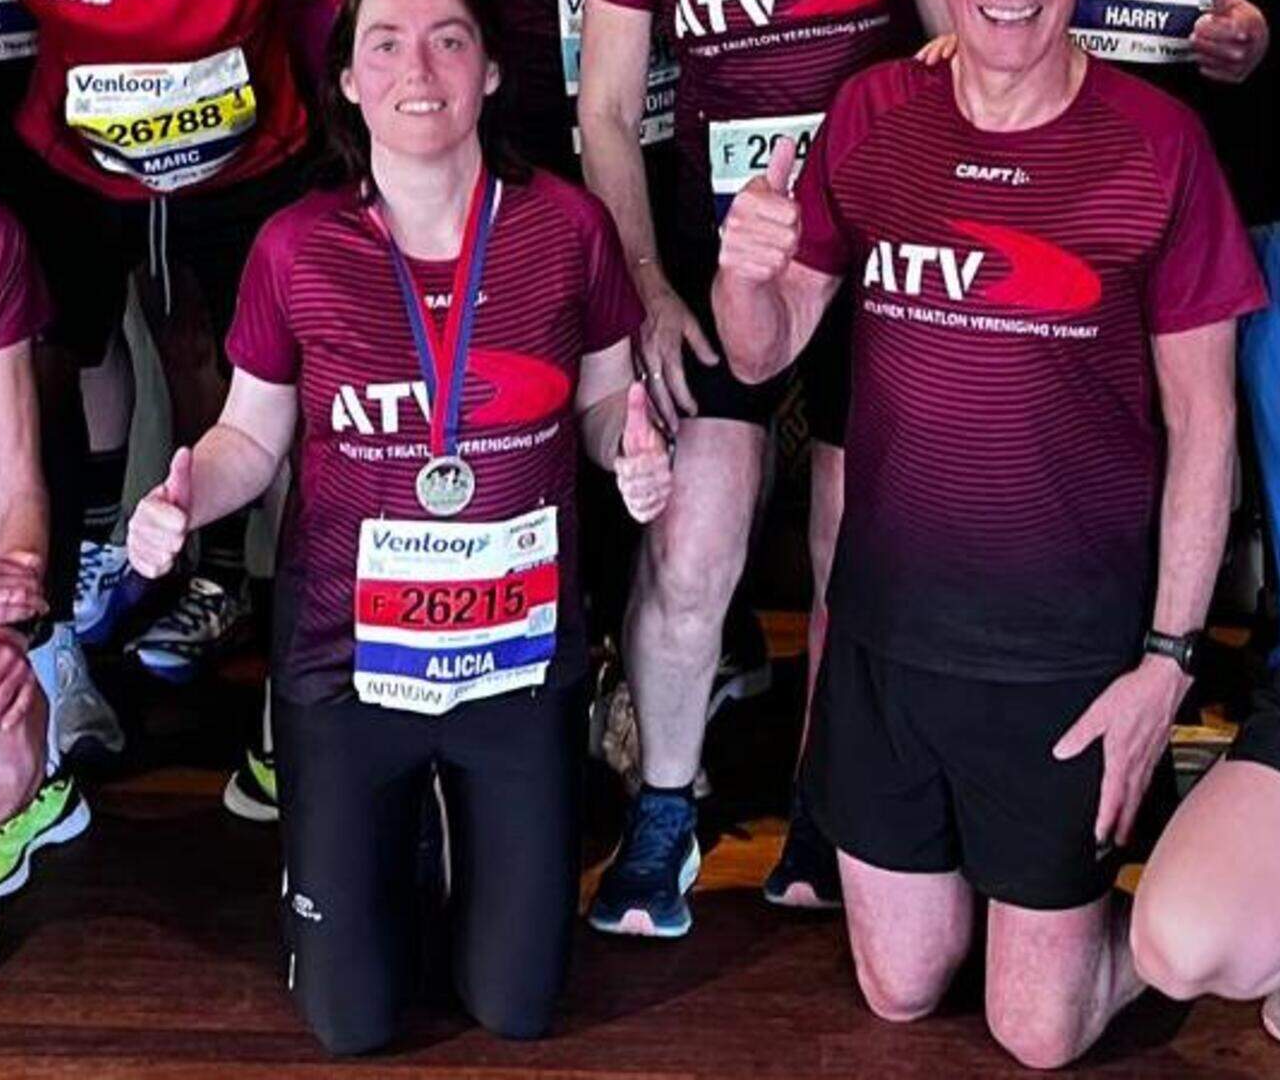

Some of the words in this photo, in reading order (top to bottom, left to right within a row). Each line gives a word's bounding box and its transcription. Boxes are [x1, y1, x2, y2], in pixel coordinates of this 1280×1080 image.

[1106, 6, 1170, 30] HARRY
[75, 74, 173, 98] Venloop
[107, 104, 223, 148] 26788
[144, 151, 201, 174] MARC
[723, 143, 736, 165] F
[956, 164, 1012, 182] CRAFT
[863, 240, 985, 301] ATV
[373, 529, 490, 558] Venloop
[373, 594, 387, 615] F
[399, 580, 525, 626] 26215
[425, 652, 496, 680] ALICIA
